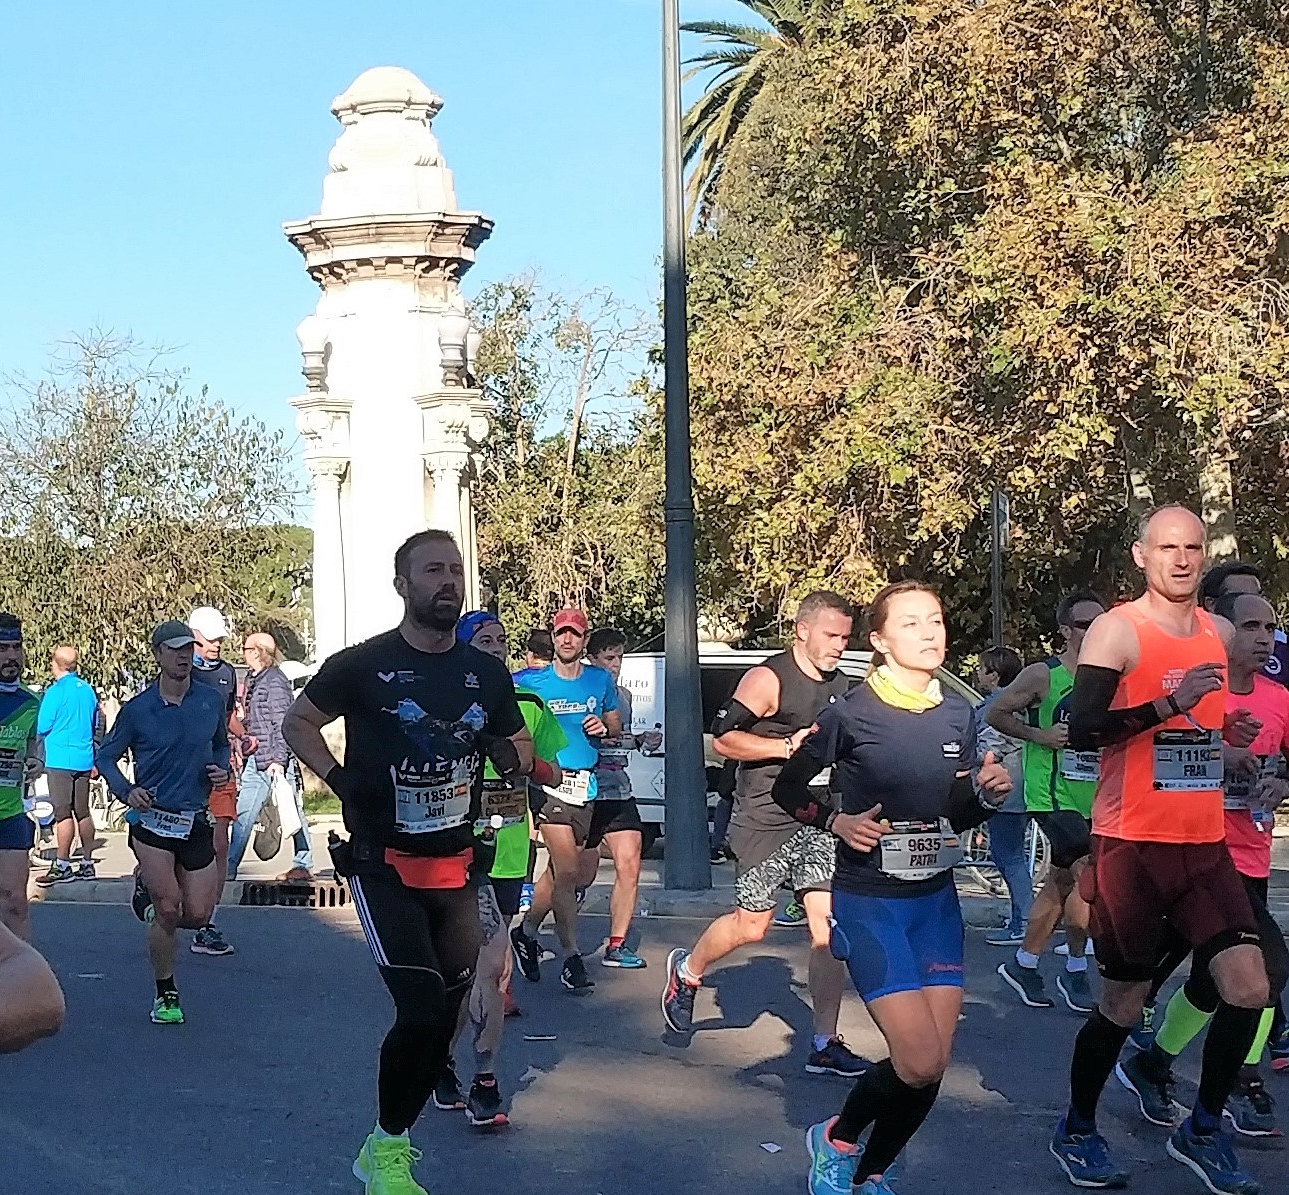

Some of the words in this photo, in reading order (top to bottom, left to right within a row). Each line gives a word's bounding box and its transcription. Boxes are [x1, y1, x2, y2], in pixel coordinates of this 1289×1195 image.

[415, 788, 454, 804] 11853
[425, 804, 445, 818] Javi
[907, 837, 941, 851] 9635
[910, 853, 937, 866] PATRI
